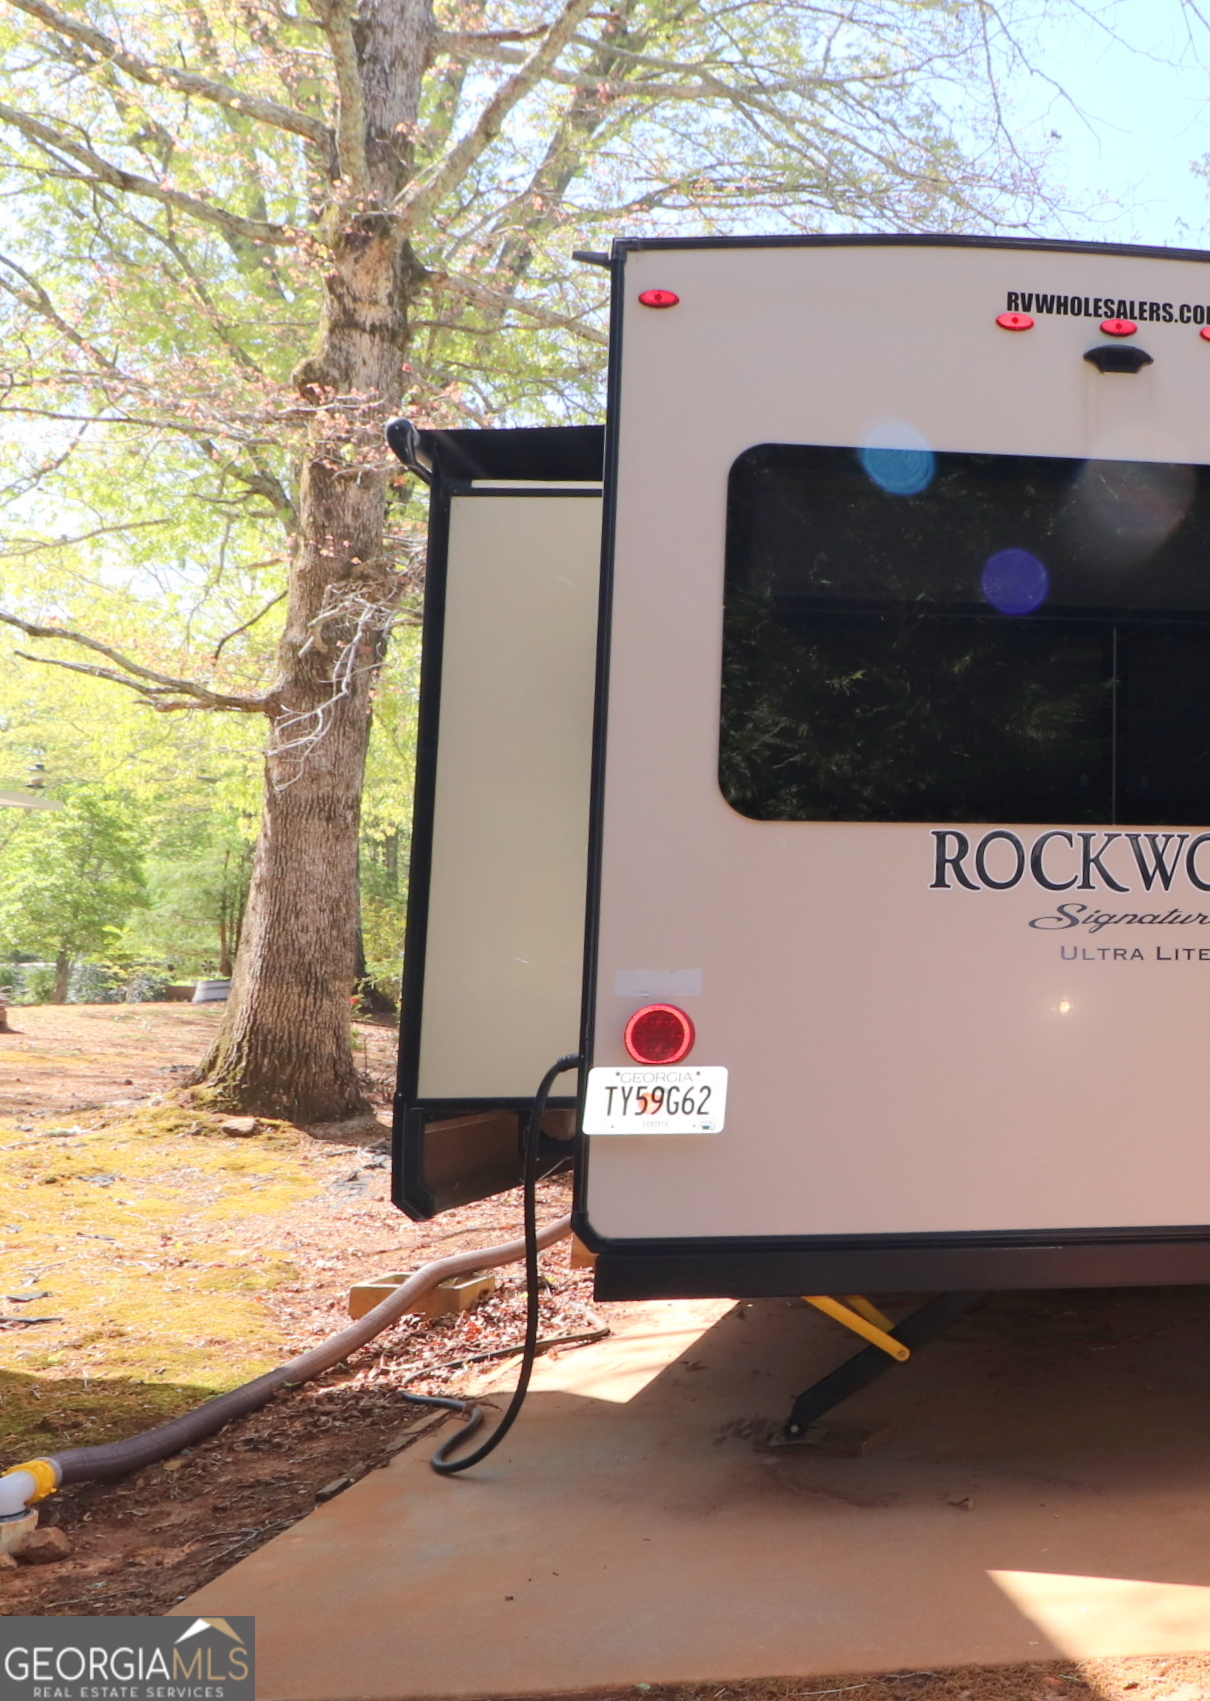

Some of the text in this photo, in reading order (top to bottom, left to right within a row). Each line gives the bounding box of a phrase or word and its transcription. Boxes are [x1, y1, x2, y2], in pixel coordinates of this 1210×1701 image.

[1060, 945, 1210, 961] ULTRA LITE
[620, 1071, 694, 1084] GEORGIA
[605, 1085, 712, 1116] TY59G62
